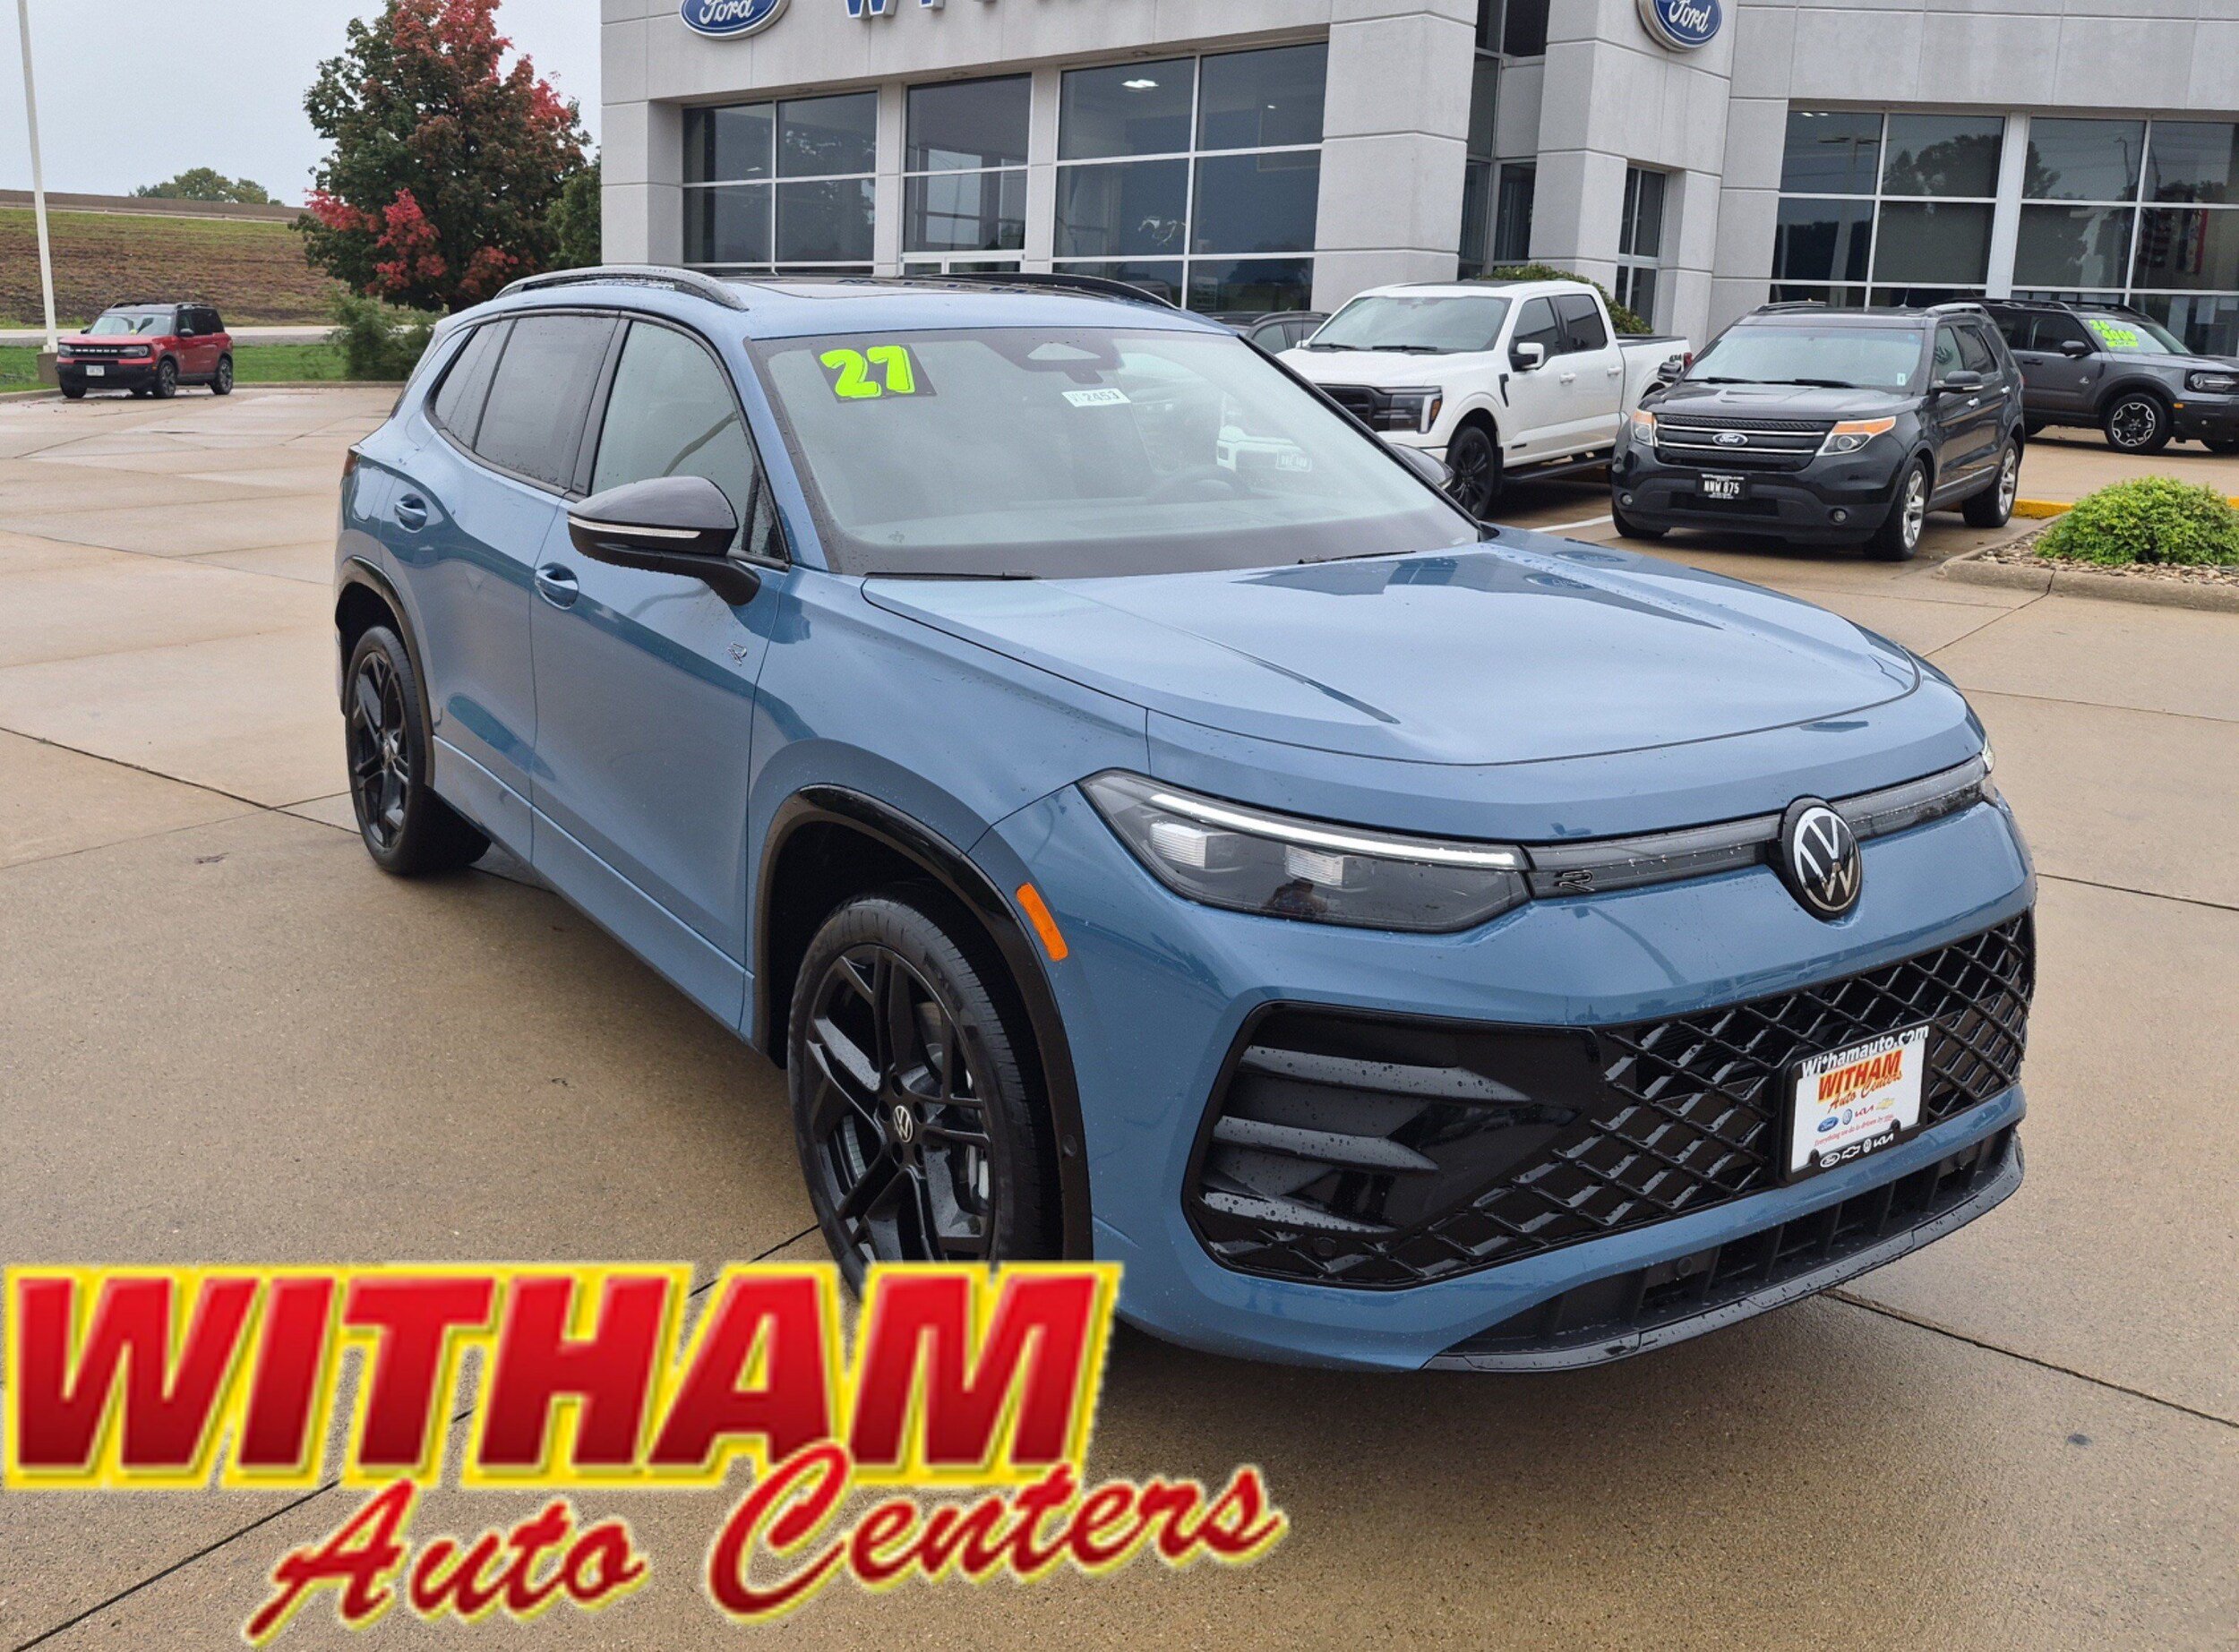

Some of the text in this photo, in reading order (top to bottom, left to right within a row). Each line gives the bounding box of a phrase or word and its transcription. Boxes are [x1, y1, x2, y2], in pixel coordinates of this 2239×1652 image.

[699, 0, 754, 24] Ford
[1668, 0, 1712, 33] Ford
[819, 345, 916, 398] 27
[1818, 1049, 1903, 1100] WITHAM
